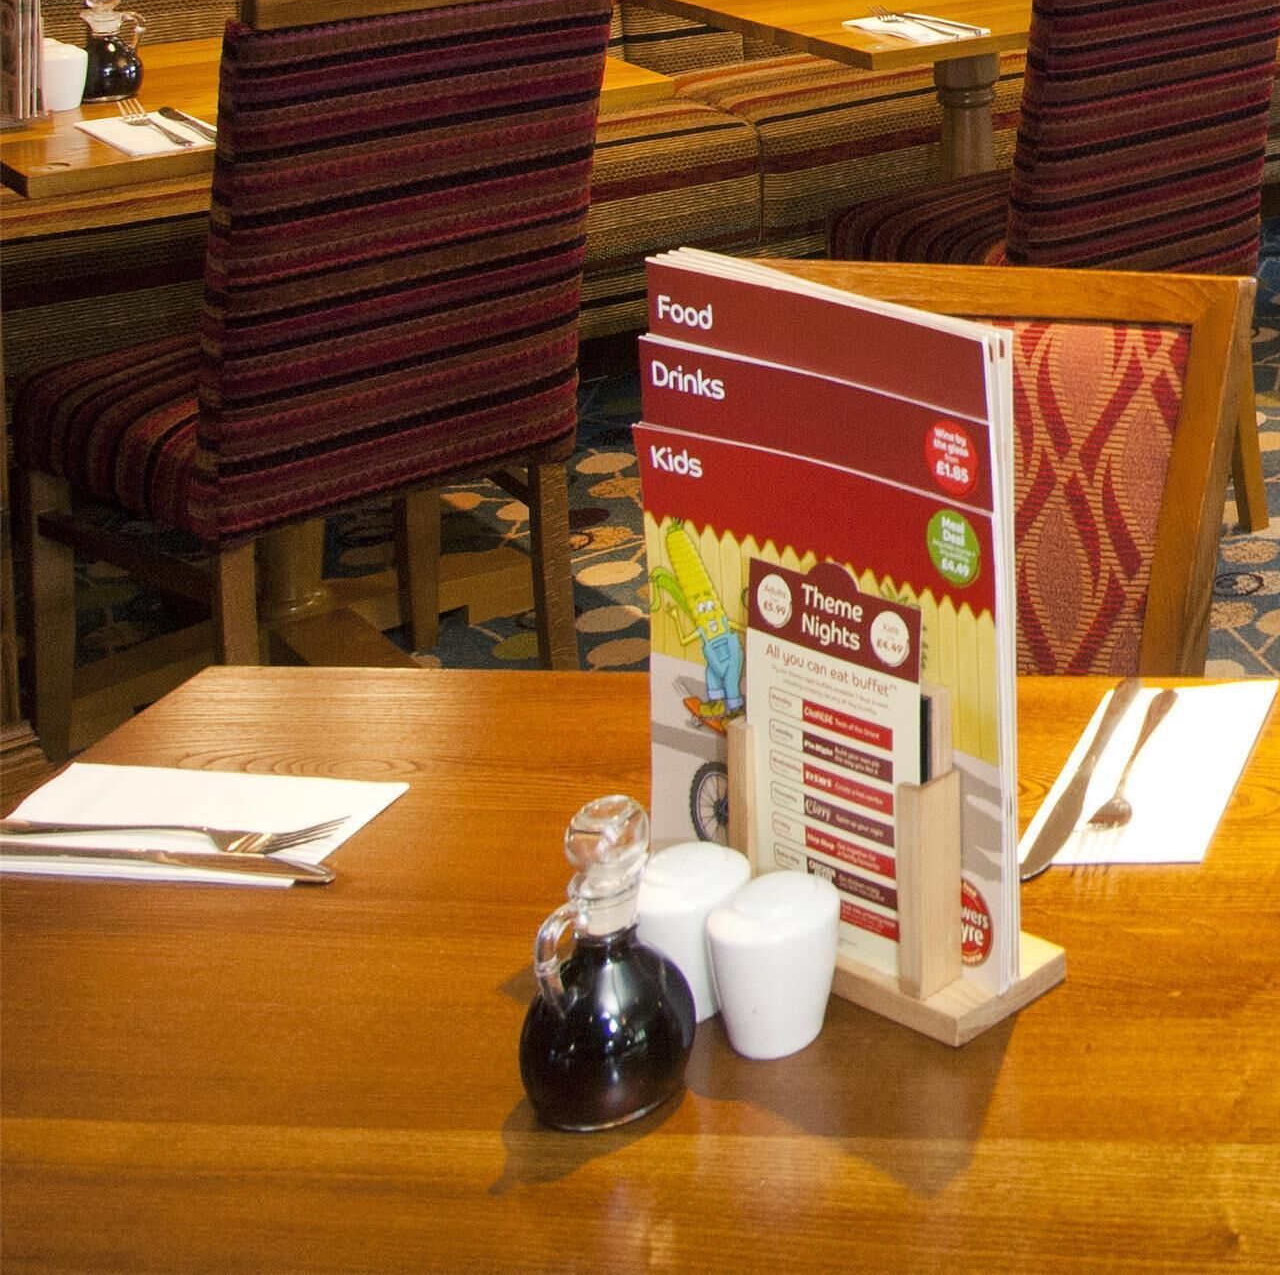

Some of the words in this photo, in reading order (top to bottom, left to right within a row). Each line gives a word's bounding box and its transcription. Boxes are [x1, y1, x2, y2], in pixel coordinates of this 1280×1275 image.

[657, 294, 713, 330] Food
[651, 360, 725, 400] Drinks
[650, 445, 703, 478] Kids
[936, 460, 969, 483] £1.85
[942, 516, 965, 534] Meal
[942, 529, 965, 547] Deal
[941, 557, 970, 577] £4.49
[764, 584, 786, 599] Adults
[801, 583, 863, 622] Theme
[763, 600, 786, 616] £5.99
[802, 613, 860, 651] Nights
[876, 638, 903, 653] £4.49
[766, 643, 780, 660] All
[783, 651, 804, 669] you
[807, 661, 827, 677] can
[830, 669, 849, 685] eat
[806, 796, 831, 823] Curry
[960, 906, 989, 929] wers
[960, 922, 984, 947] yre
